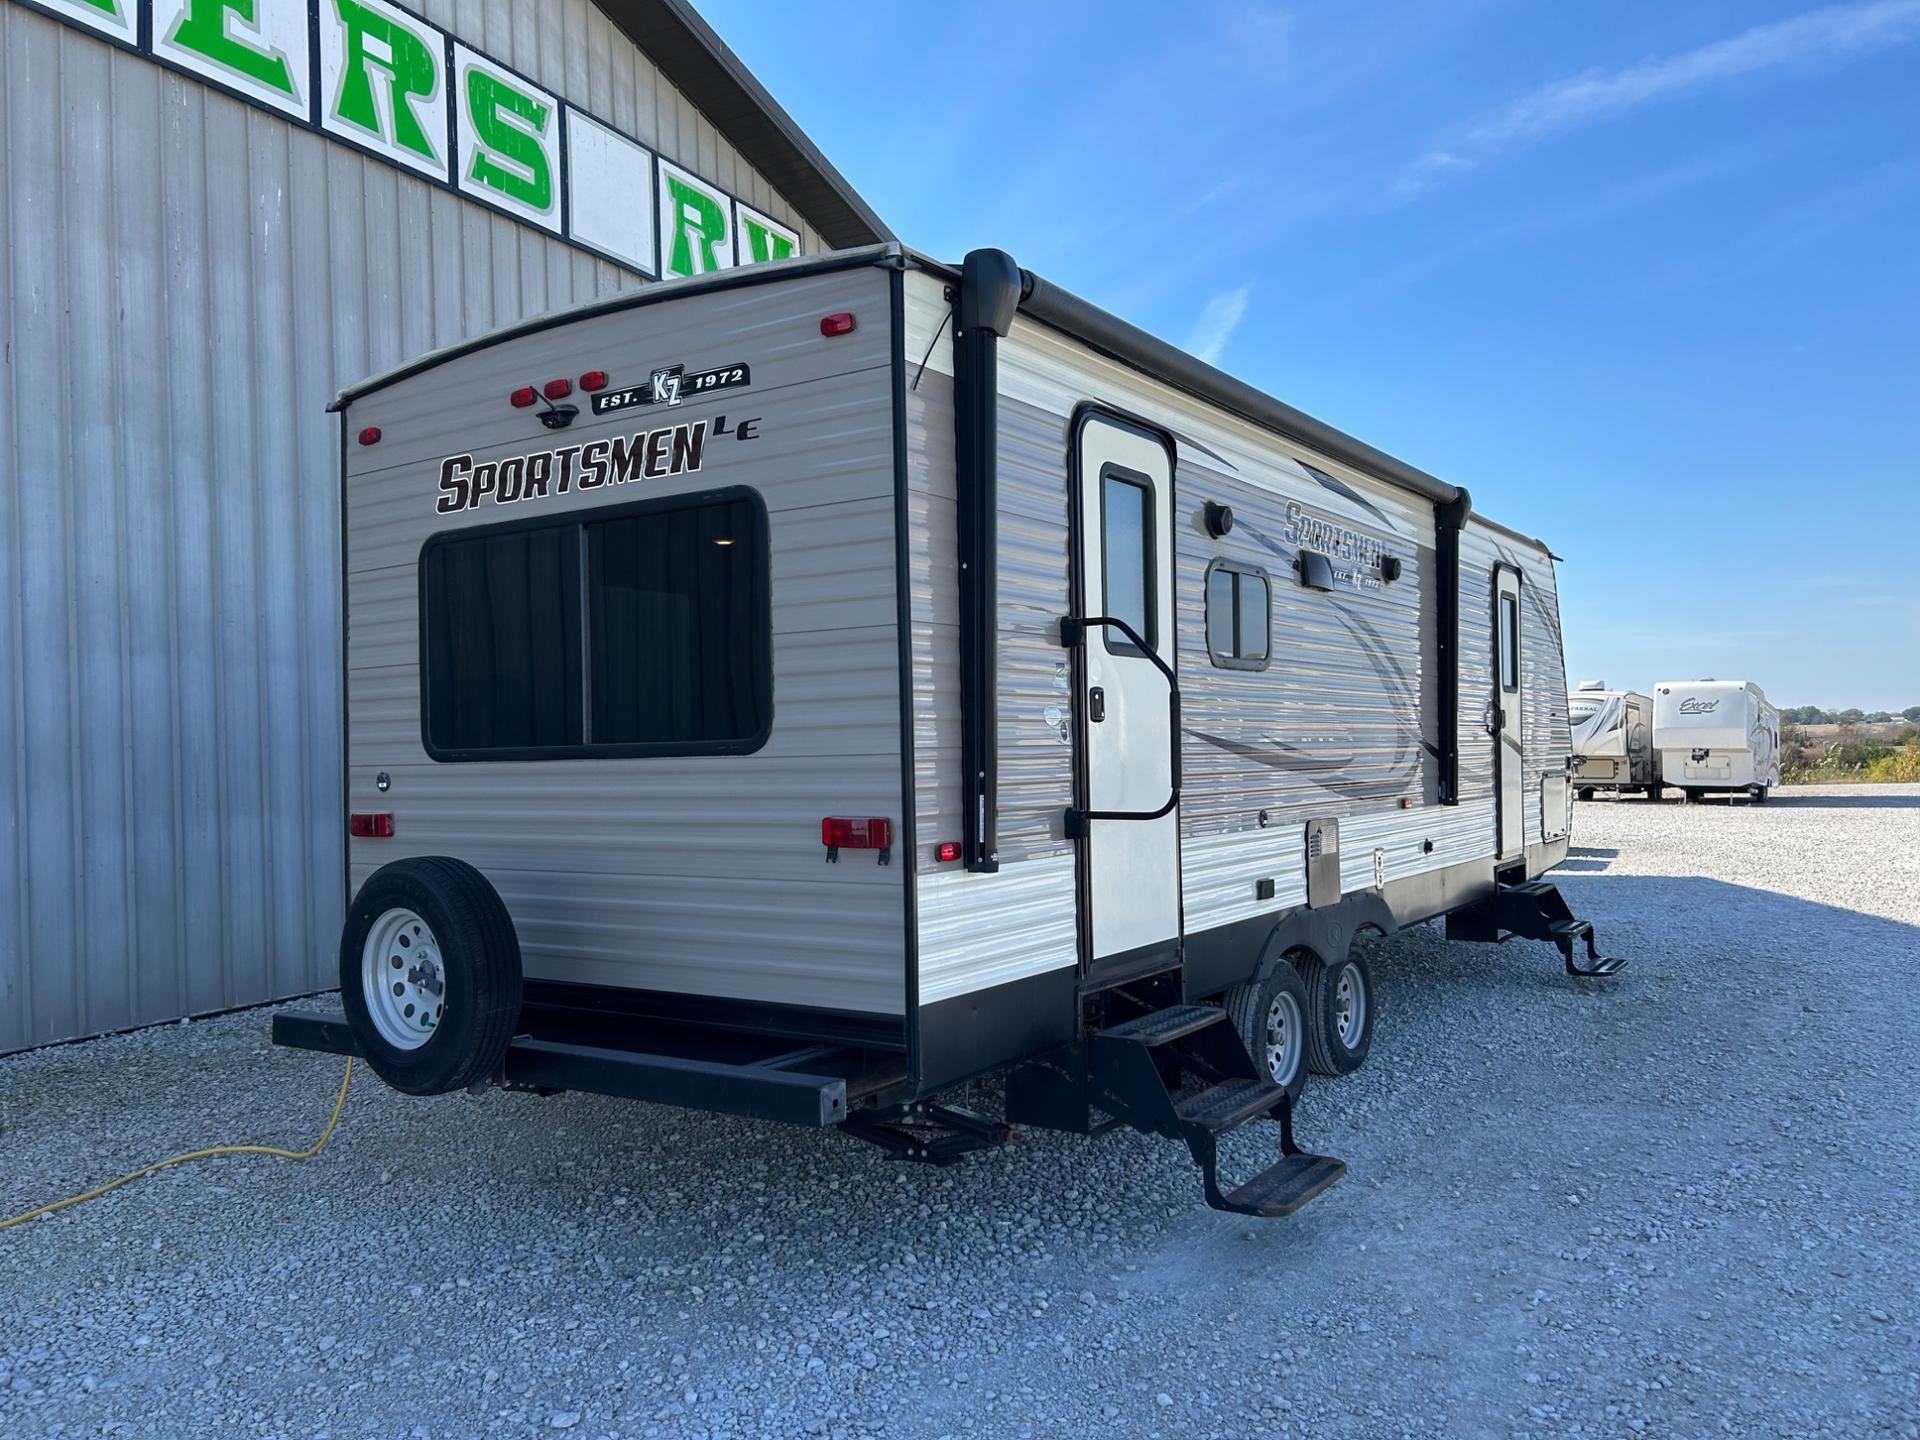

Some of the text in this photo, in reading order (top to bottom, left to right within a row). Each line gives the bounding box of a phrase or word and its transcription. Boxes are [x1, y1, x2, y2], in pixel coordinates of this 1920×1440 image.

[64, 0, 556, 215] ERS
[599, 368, 744, 410] EST. KZ 1972
[713, 415, 762, 442] LE
[1679, 697, 1720, 714] Excel
